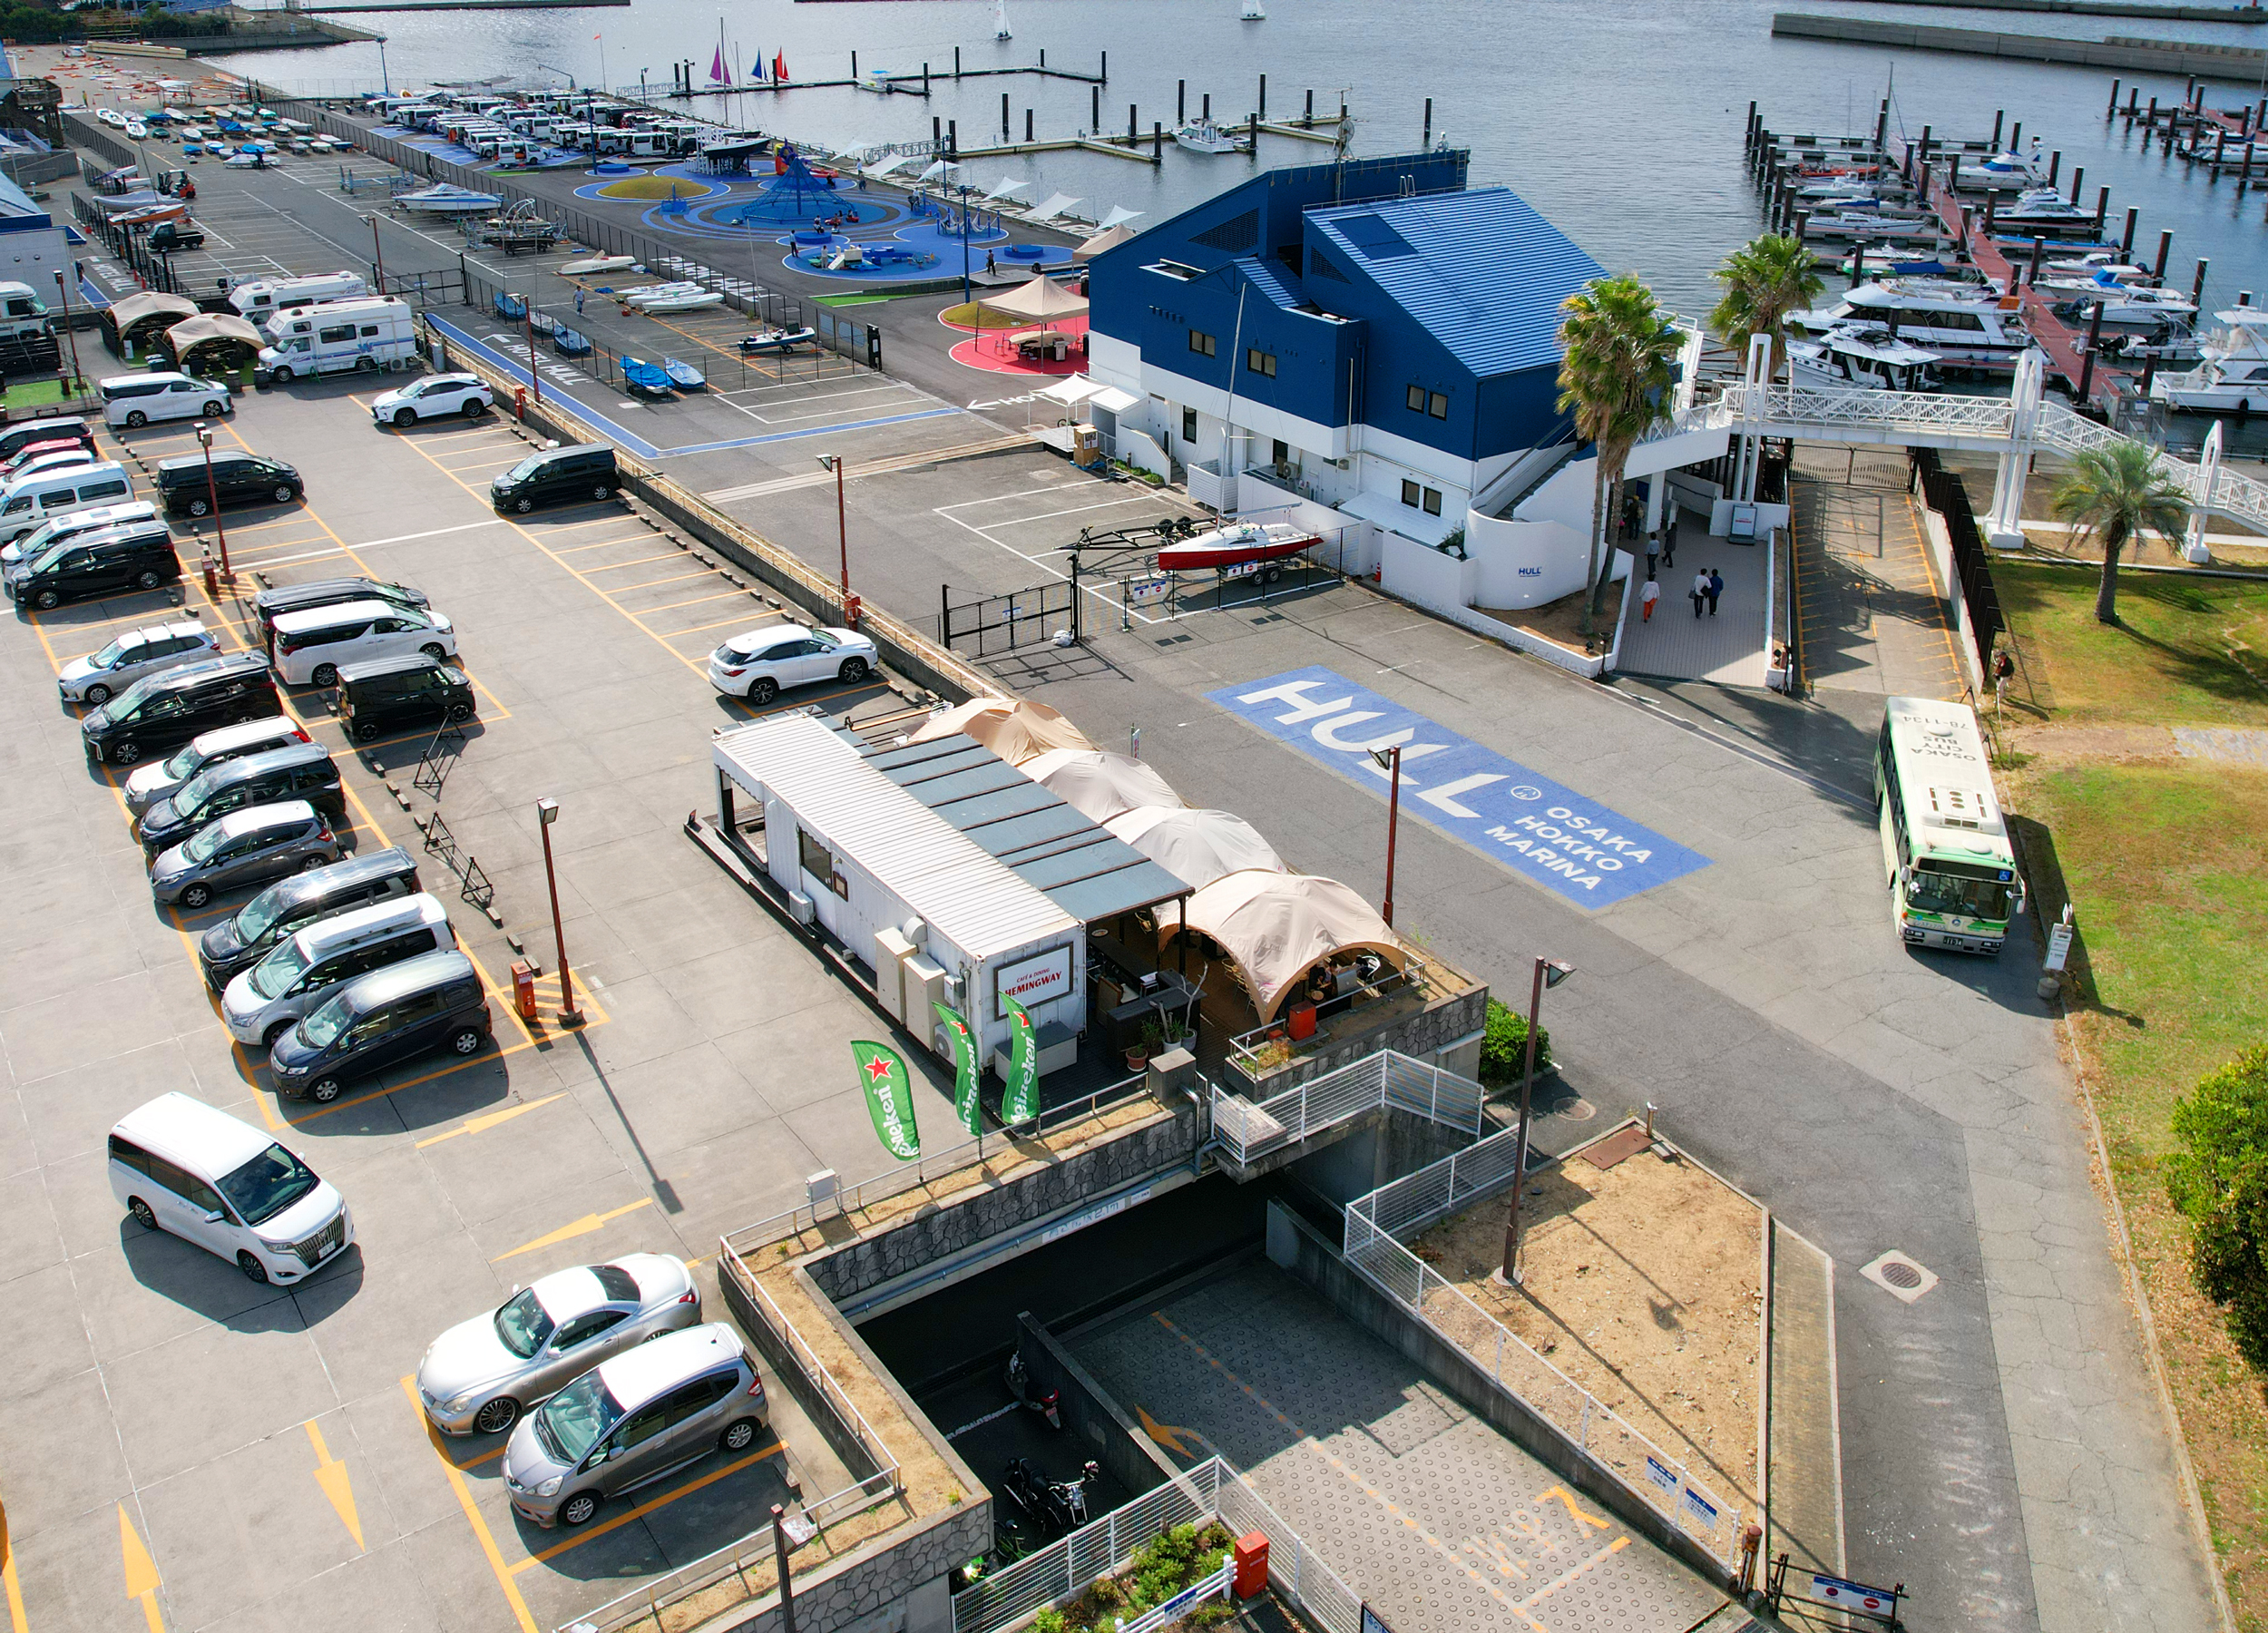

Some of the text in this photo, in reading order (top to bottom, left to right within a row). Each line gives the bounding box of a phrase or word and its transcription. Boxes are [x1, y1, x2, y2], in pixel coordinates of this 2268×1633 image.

[503, 344, 590, 386] HOTEL HULL
[1519, 566, 1541, 575] HULL
[1903, 716, 1970, 730] 78-1134
[1237, 680, 1510, 818] HULL
[1922, 743, 1962, 752] CITY
[1923, 736, 1958, 745] BUS
[1911, 748, 1977, 761] OSAKA
[1514, 815, 1623, 872] HOKKO
[1547, 807, 1652, 864] OSAKA
[1484, 825, 1603, 891] MARINA
[1033, 967, 1051, 978] DINING
[1004, 971, 1062, 997] HEMINGWAY
